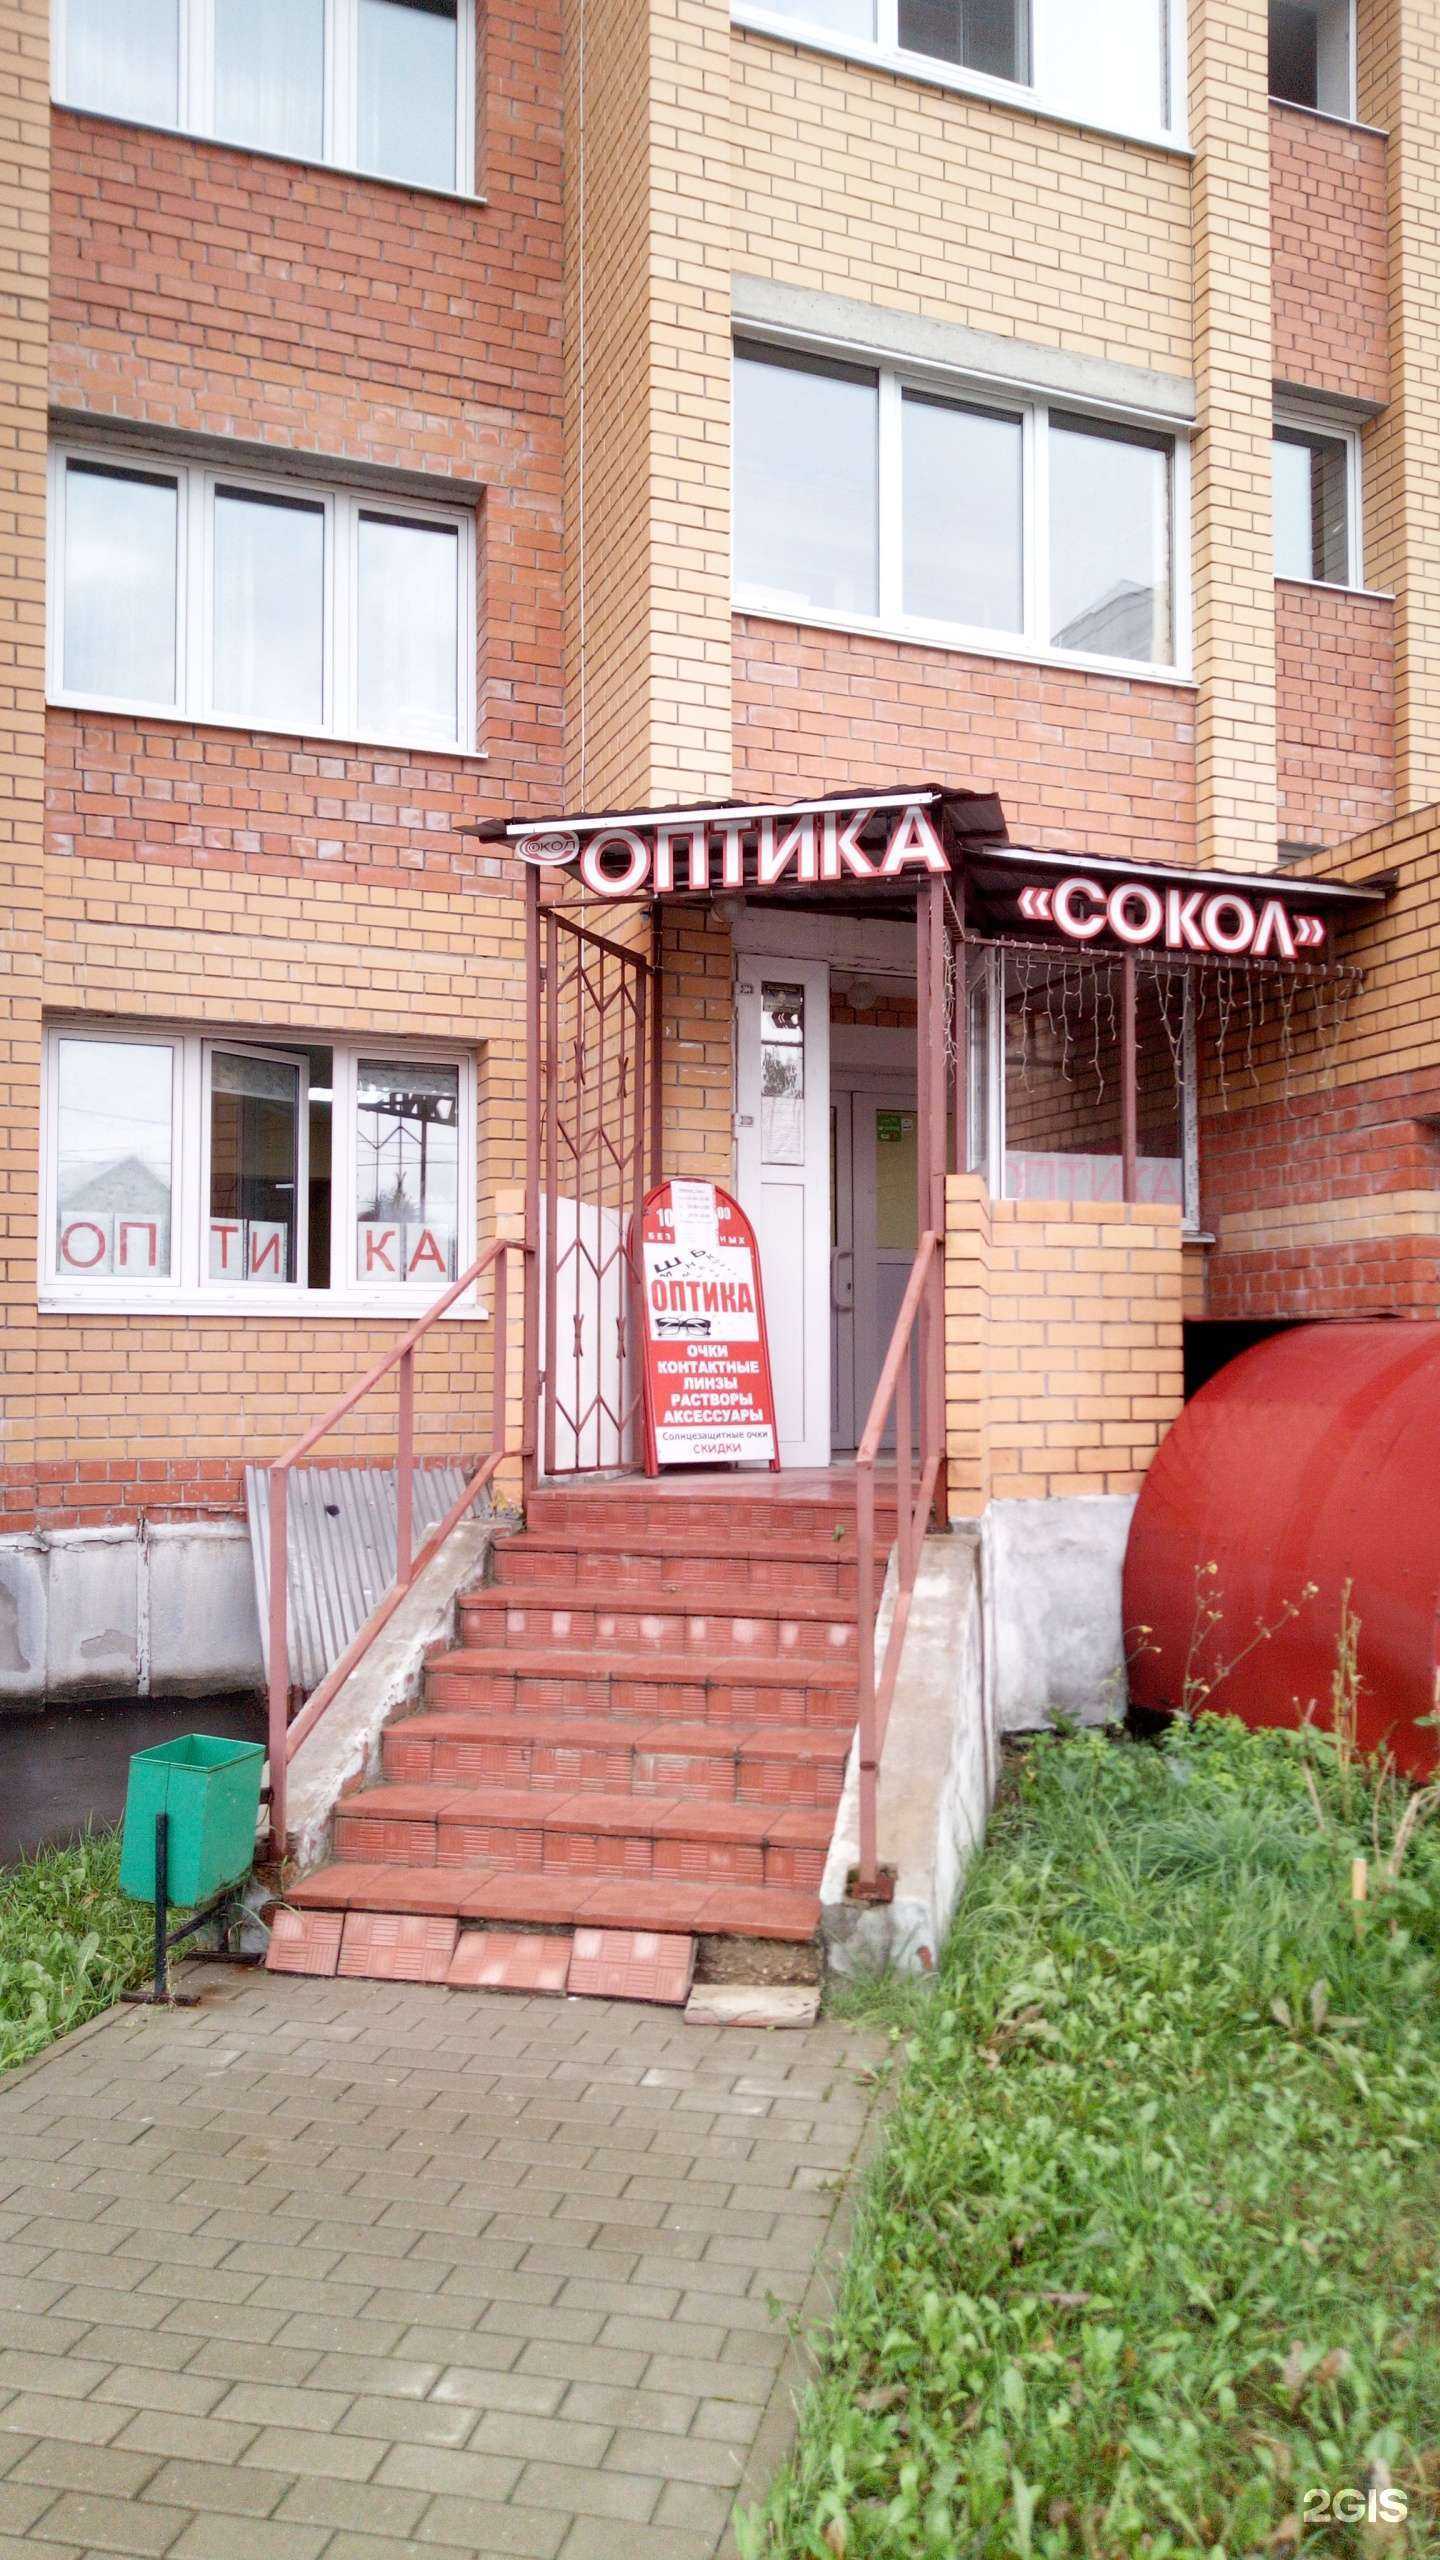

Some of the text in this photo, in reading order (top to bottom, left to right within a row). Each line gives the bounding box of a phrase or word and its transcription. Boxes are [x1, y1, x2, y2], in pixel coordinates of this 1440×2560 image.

[580, 803, 951, 896] ОПТИКА
[1017, 877, 1325, 958] «СОКОЛ»
[651, 1279, 754, 1313] ОПТИКА
[687, 1344, 728, 1358] ОЧКИ
[657, 1360, 760, 1374] КОНТАКТНЫЕ
[683, 1376, 738, 1390] ЛИНЗЫ
[671, 1392, 753, 1406] РАСТВОРЫ
[663, 1408, 764, 1423] АКСЕССУАРЫ
[662, 1430, 768, 1441] Солнцезащитные очки
[693, 1442, 742, 1455] СКИДКИ
